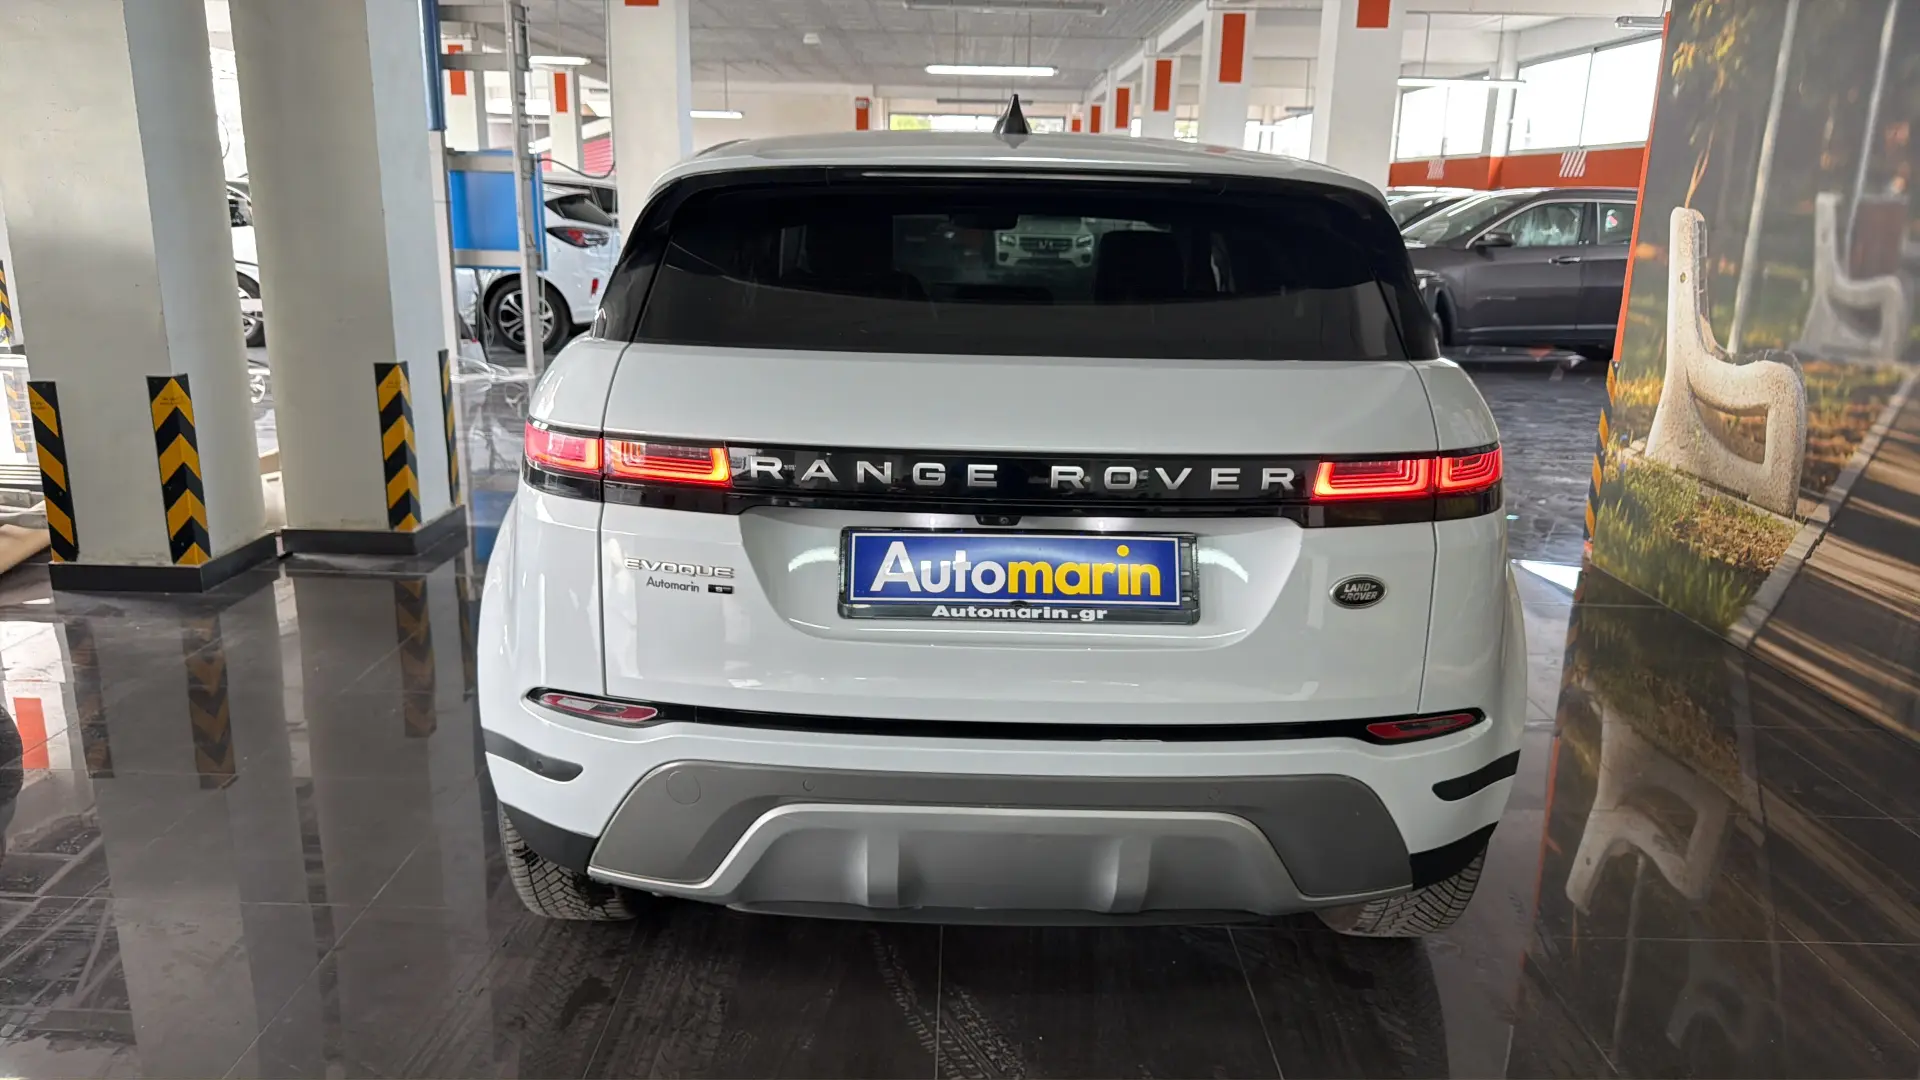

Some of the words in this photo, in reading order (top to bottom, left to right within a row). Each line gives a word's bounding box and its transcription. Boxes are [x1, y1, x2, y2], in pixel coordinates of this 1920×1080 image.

[749, 456, 998, 488] RANGE
[1050, 465, 1296, 491] ROVER
[624, 558, 735, 578] EVOQUE
[870, 541, 1161, 596] Automarin
[646, 577, 699, 592] Automarin
[1344, 583, 1371, 593] LAND
[1346, 592, 1378, 601] ROVER
[931, 605, 1108, 621] Automarin.gr
